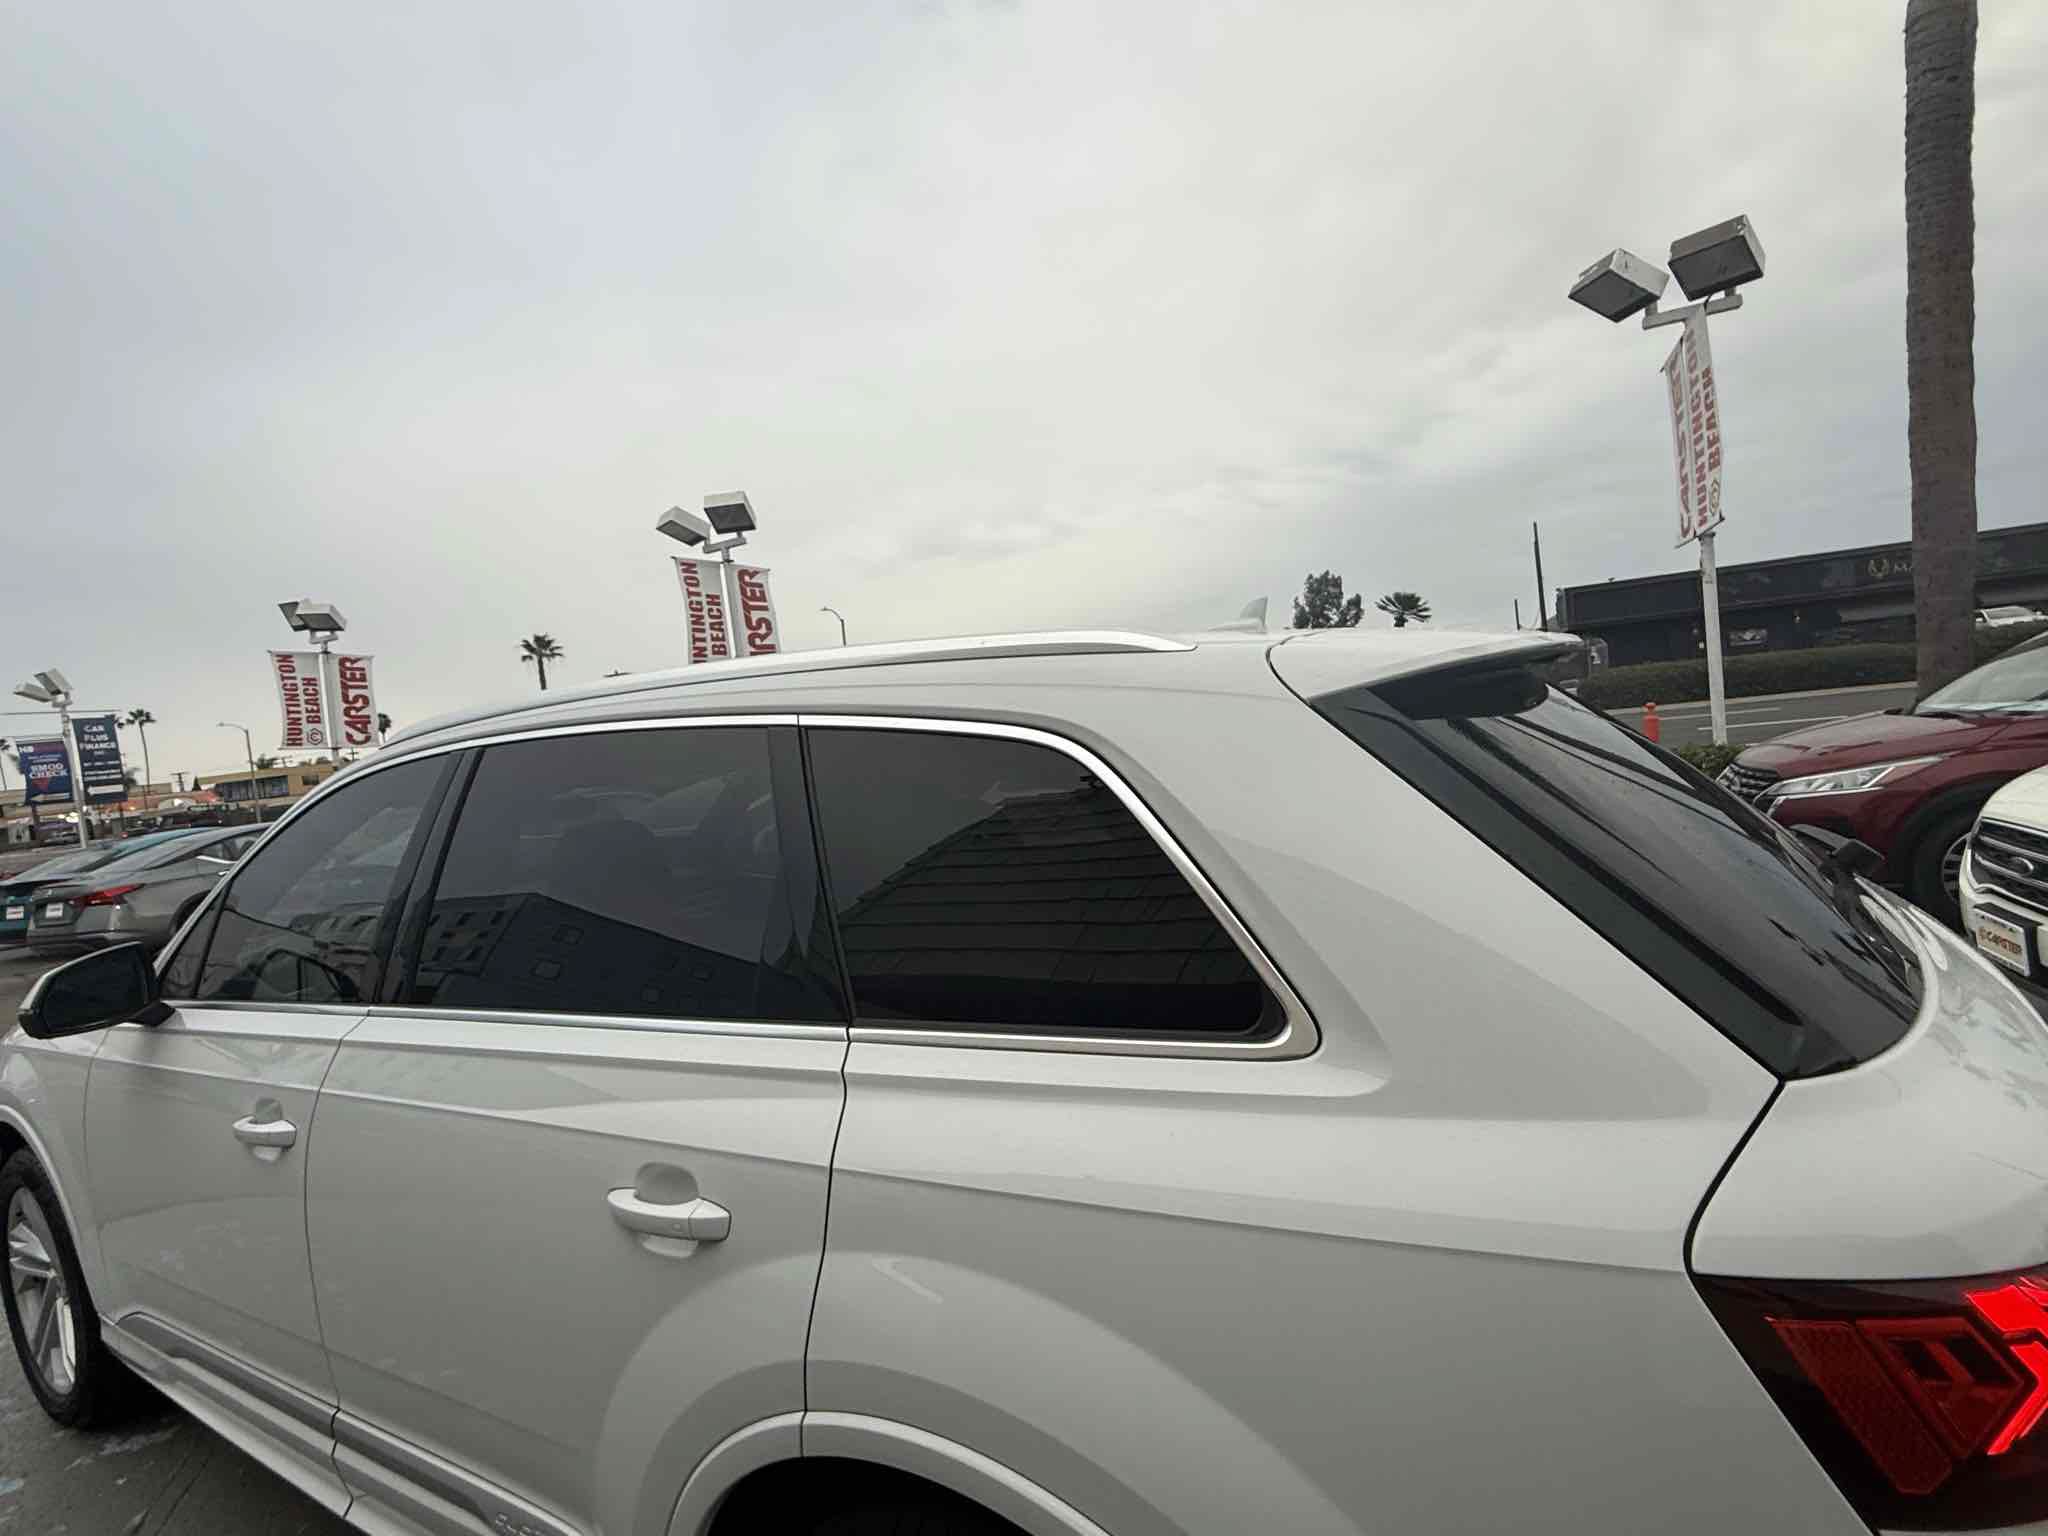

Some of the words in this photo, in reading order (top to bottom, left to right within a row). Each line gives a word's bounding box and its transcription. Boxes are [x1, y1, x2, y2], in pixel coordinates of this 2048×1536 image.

[1702, 367, 1720, 471] BEACH
[680, 562, 707, 663] NTINGTON
[706, 594, 727, 656] BEACH
[738, 569, 776, 656] RSTER
[275, 654, 303, 746] HUNTINGTON
[302, 677, 321, 724] BEACH
[339, 656, 372, 745] CARSTER
